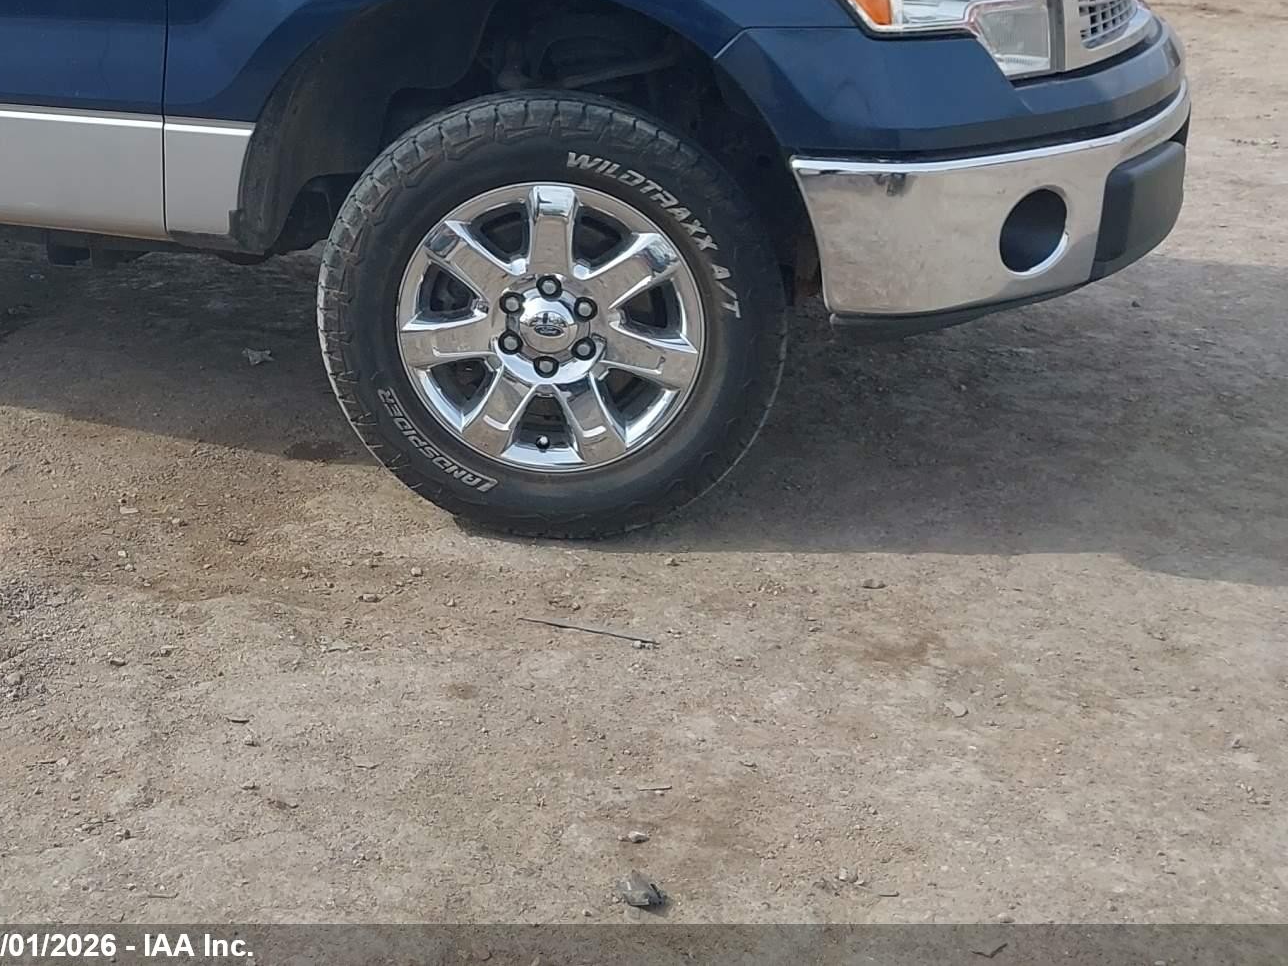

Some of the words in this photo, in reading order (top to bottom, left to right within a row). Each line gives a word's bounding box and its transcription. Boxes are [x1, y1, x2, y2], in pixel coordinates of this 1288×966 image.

[566, 151, 719, 251] WILDTRAXX
[710, 263, 742, 319] A/T
[376, 386, 498, 493] LANDSPIDER
